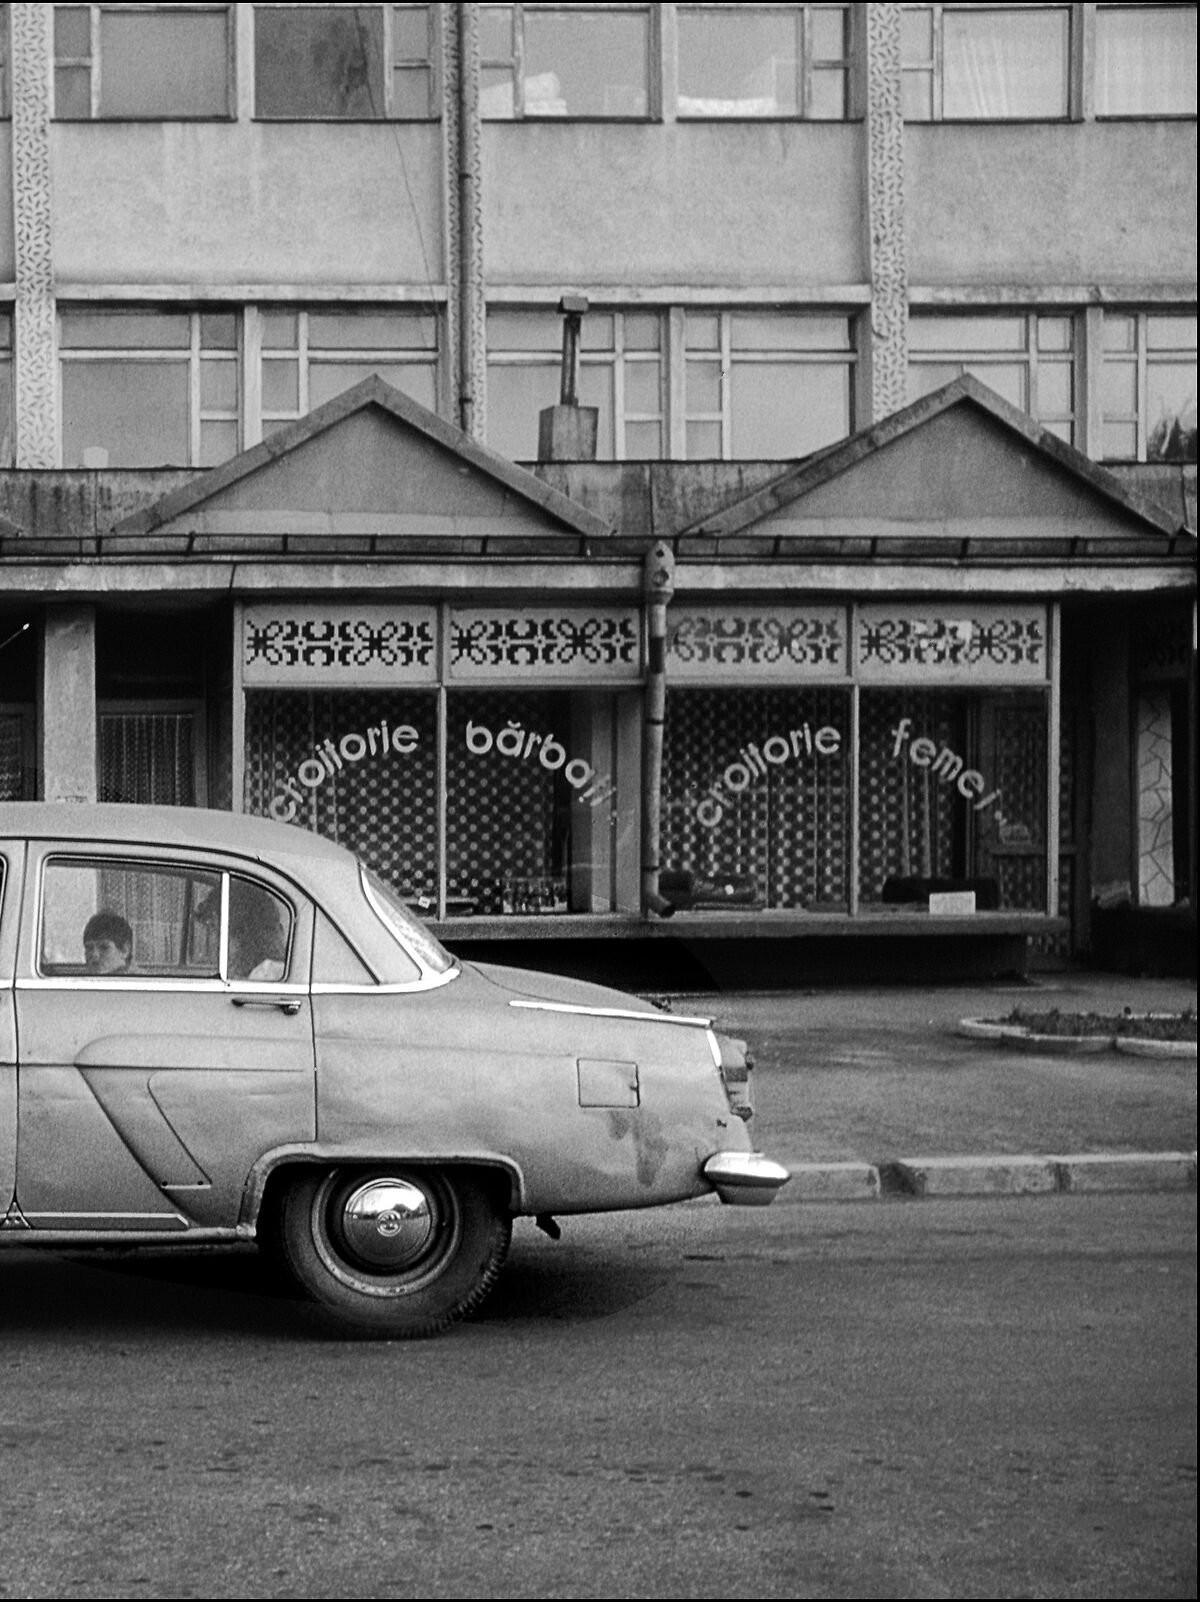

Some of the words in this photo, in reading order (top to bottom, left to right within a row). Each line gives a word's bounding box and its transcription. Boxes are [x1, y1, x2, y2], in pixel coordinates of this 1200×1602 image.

[269, 719, 420, 823] croitorie
[696, 721, 842, 827] croitorie
[890, 717, 1002, 811] femei
